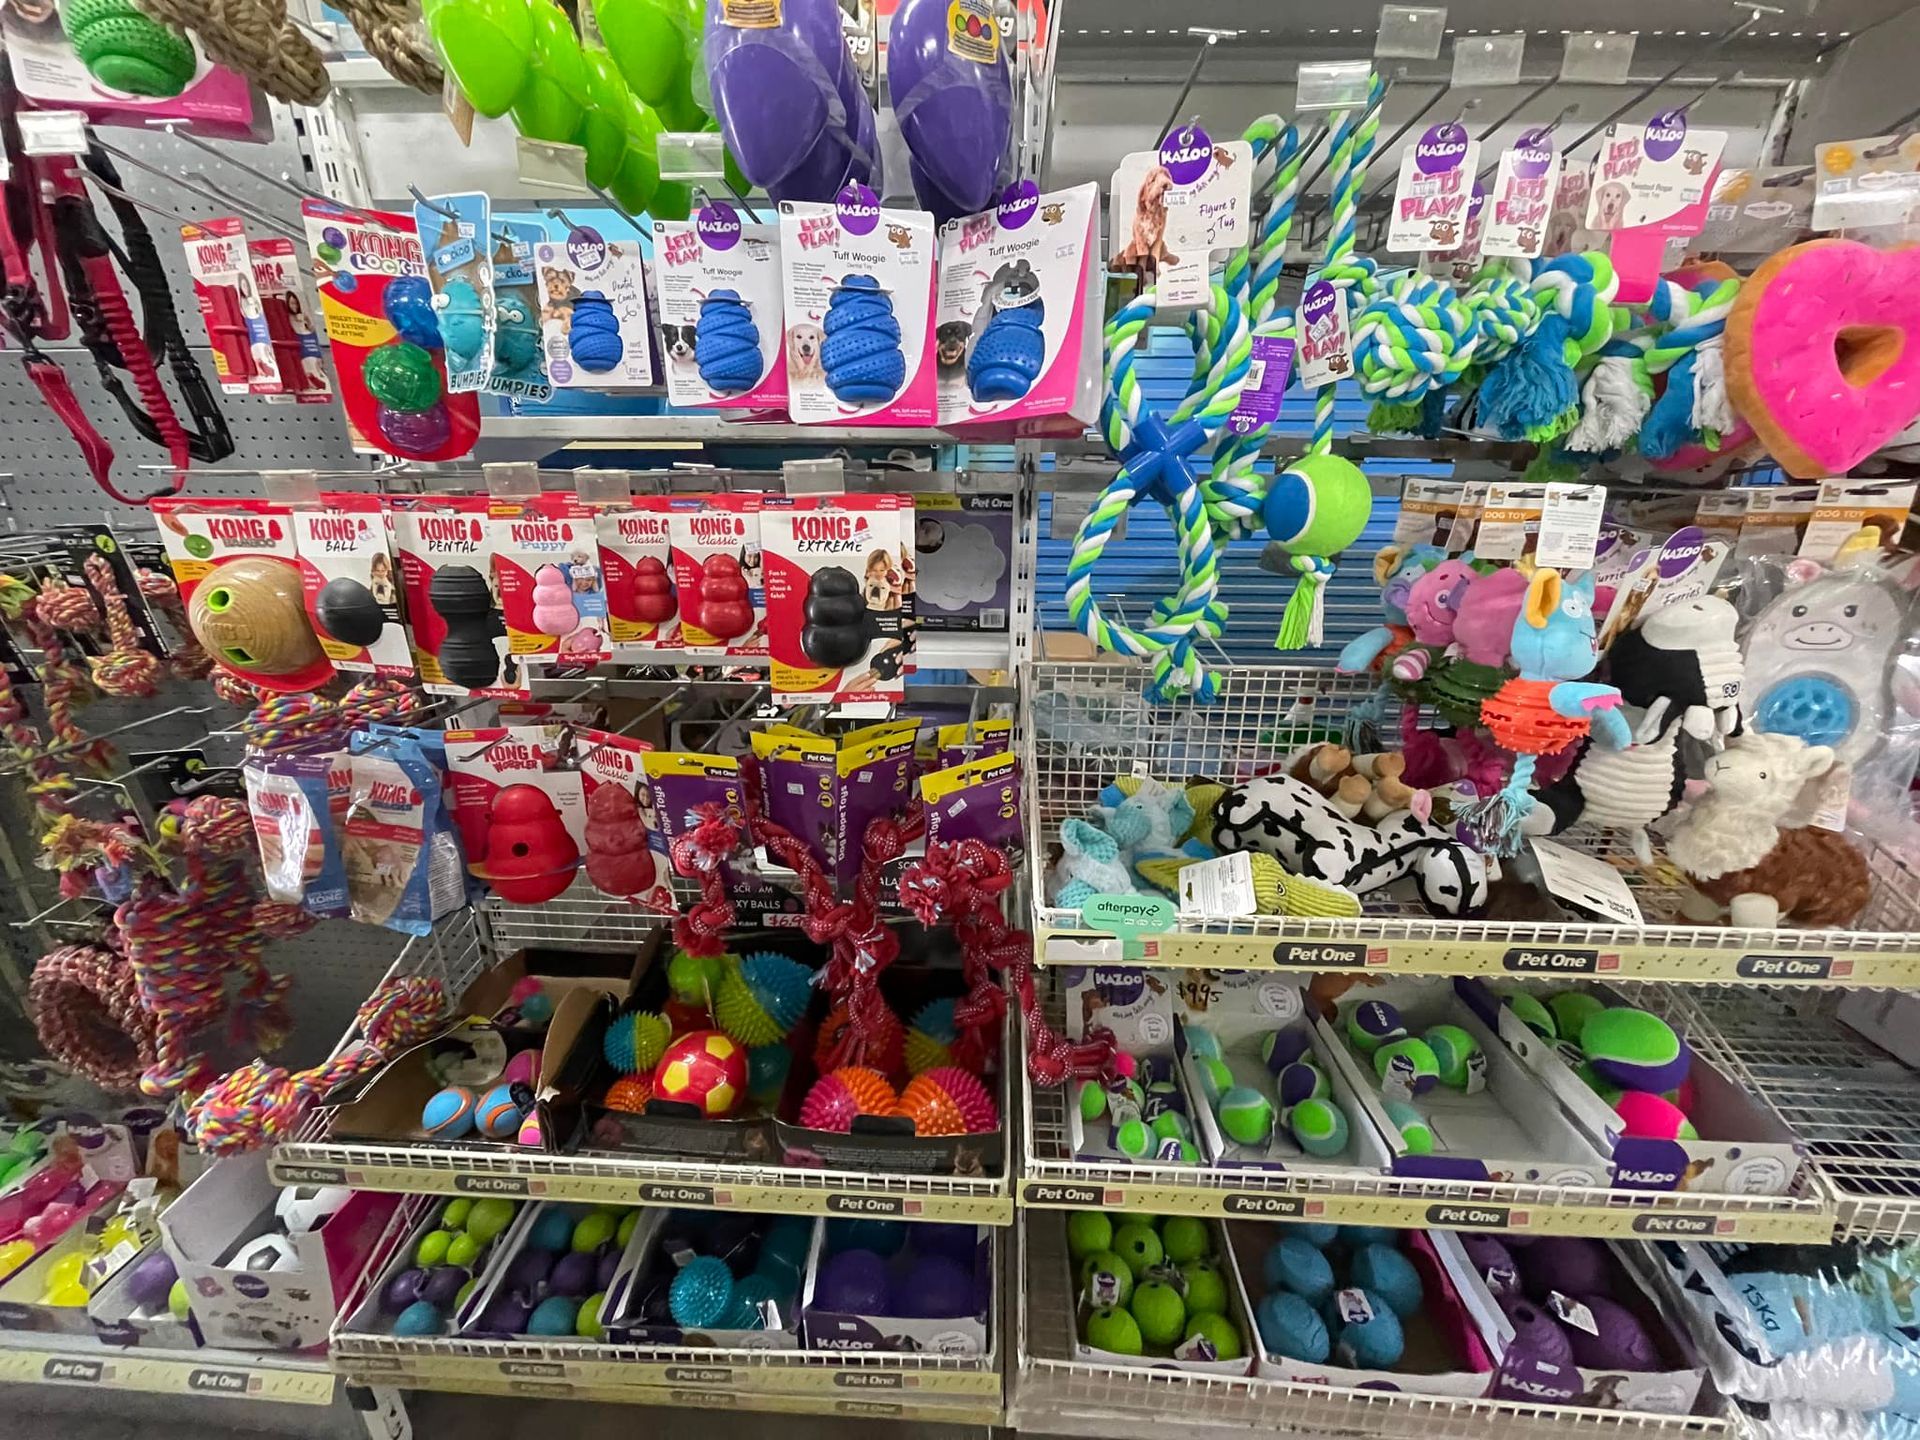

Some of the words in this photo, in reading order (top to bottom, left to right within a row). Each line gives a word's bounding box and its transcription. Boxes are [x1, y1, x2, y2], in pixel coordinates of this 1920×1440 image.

[1645, 126, 1684, 141] KAZOO
[1418, 143, 1465, 157] KAZOO
[1610, 136, 1640, 160] LET'S
[1161, 147, 1210, 165] KAZOO
[1514, 150, 1550, 162] KAZOO
[1604, 156, 1642, 180] PLAY!
[837, 204, 880, 216] KAZOO
[998, 197, 1038, 214] KAZOO
[1200, 202, 1228, 216] Figure
[1229, 198, 1236, 210] 8
[1400, 194, 1466, 220] PLAY!
[698, 222, 740, 234] KAZOO
[1218, 217, 1236, 230] Tug
[347, 228, 423, 264] KONG
[664, 231, 696, 252] LET'S
[798, 228, 840, 251] PLAY!
[959, 227, 997, 254] PLAY!
[196, 243, 226, 266] KONG
[568, 244, 604, 255] KAZOO
[988, 245, 1006, 258] Tuff
[1006, 238, 1040, 253] Woogie
[664, 246, 703, 268] PLAY!
[833, 250, 849, 261] Tuff
[852, 252, 886, 263] Woogie
[717, 268, 743, 276] Woogie
[1304, 293, 1336, 313] KAZOO
[1301, 332, 1345, 364] PLAY!
[450, 371, 488, 388] BUMPIES
[491, 378, 552, 398] UMPIES
[972, 498, 989, 508] Pet
[1484, 510, 1506, 520] DOG
[1508, 511, 1527, 520] TOY
[1816, 509, 1841, 518] DOG
[207, 518, 266, 540] KONG
[310, 518, 356, 541] KONG
[418, 518, 468, 542] KONG
[512, 524, 558, 542] KONG
[618, 519, 656, 536] KONG
[690, 518, 732, 536] KONG
[792, 516, 851, 540] KONG
[326, 541, 358, 552] BALL
[429, 540, 478, 554] DENTAL
[520, 540, 567, 552] Puppy
[625, 534, 666, 546] Classic
[697, 534, 738, 546] Classic
[798, 540, 862, 552] EXTREME
[1660, 546, 1700, 561] KAZOO
[1663, 586, 1700, 604] Furries
[484, 745, 530, 762] KONG
[590, 746, 622, 769] KONG
[806, 753, 818, 762] Pet
[819, 754, 834, 762] One
[890, 746, 902, 756] Pet
[902, 744, 913, 754] One
[493, 760, 538, 772] WOBBLER
[596, 764, 628, 781] Classic
[988, 768, 1000, 779] Pet
[1000, 766, 1014, 776] One
[370, 781, 406, 804] KONG
[654, 786, 663, 809] Toys
[840, 785, 848, 812] Toys
[659, 811, 672, 836] Rope
[930, 812, 941, 835] Toys
[308, 894, 344, 905] KONG
[750, 900, 781, 909] BALLS
[1097, 902, 1146, 916] afterpay
[1288, 947, 1318, 962] Pet
[1323, 948, 1356, 962] One
[1518, 953, 1548, 967] Pet
[1552, 954, 1587, 968] One
[1752, 960, 1784, 974] Pet
[1786, 962, 1821, 974] One
[1096, 974, 1142, 986] KAZOO
[1177, 983, 1224, 1010] $9.95
[1618, 1170, 1676, 1182] KAZOO
[467, 1178, 491, 1189] Pet
[494, 1180, 520, 1191] One
[652, 1188, 676, 1198] Pet
[678, 1189, 706, 1200] One
[1037, 1188, 1062, 1200] Pet
[1065, 1190, 1095, 1201] One
[840, 1198, 864, 1210] Pet
[867, 1200, 895, 1211] One
[1236, 1198, 1263, 1210] Pet
[1266, 1200, 1296, 1212] One
[1439, 1209, 1466, 1222] Pet
[1468, 1210, 1500, 1223] One
[1646, 1218, 1674, 1230] Pet
[1676, 1220, 1706, 1231] One
[816, 1338, 874, 1350] KAZOO
[197, 1374, 218, 1386] Pet
[218, 1376, 242, 1388] One
[676, 1369, 700, 1380] Pet
[702, 1370, 727, 1381] One
[846, 1374, 868, 1385] Pet
[870, 1376, 895, 1386] One
[1501, 1374, 1573, 1398] KAZOO
